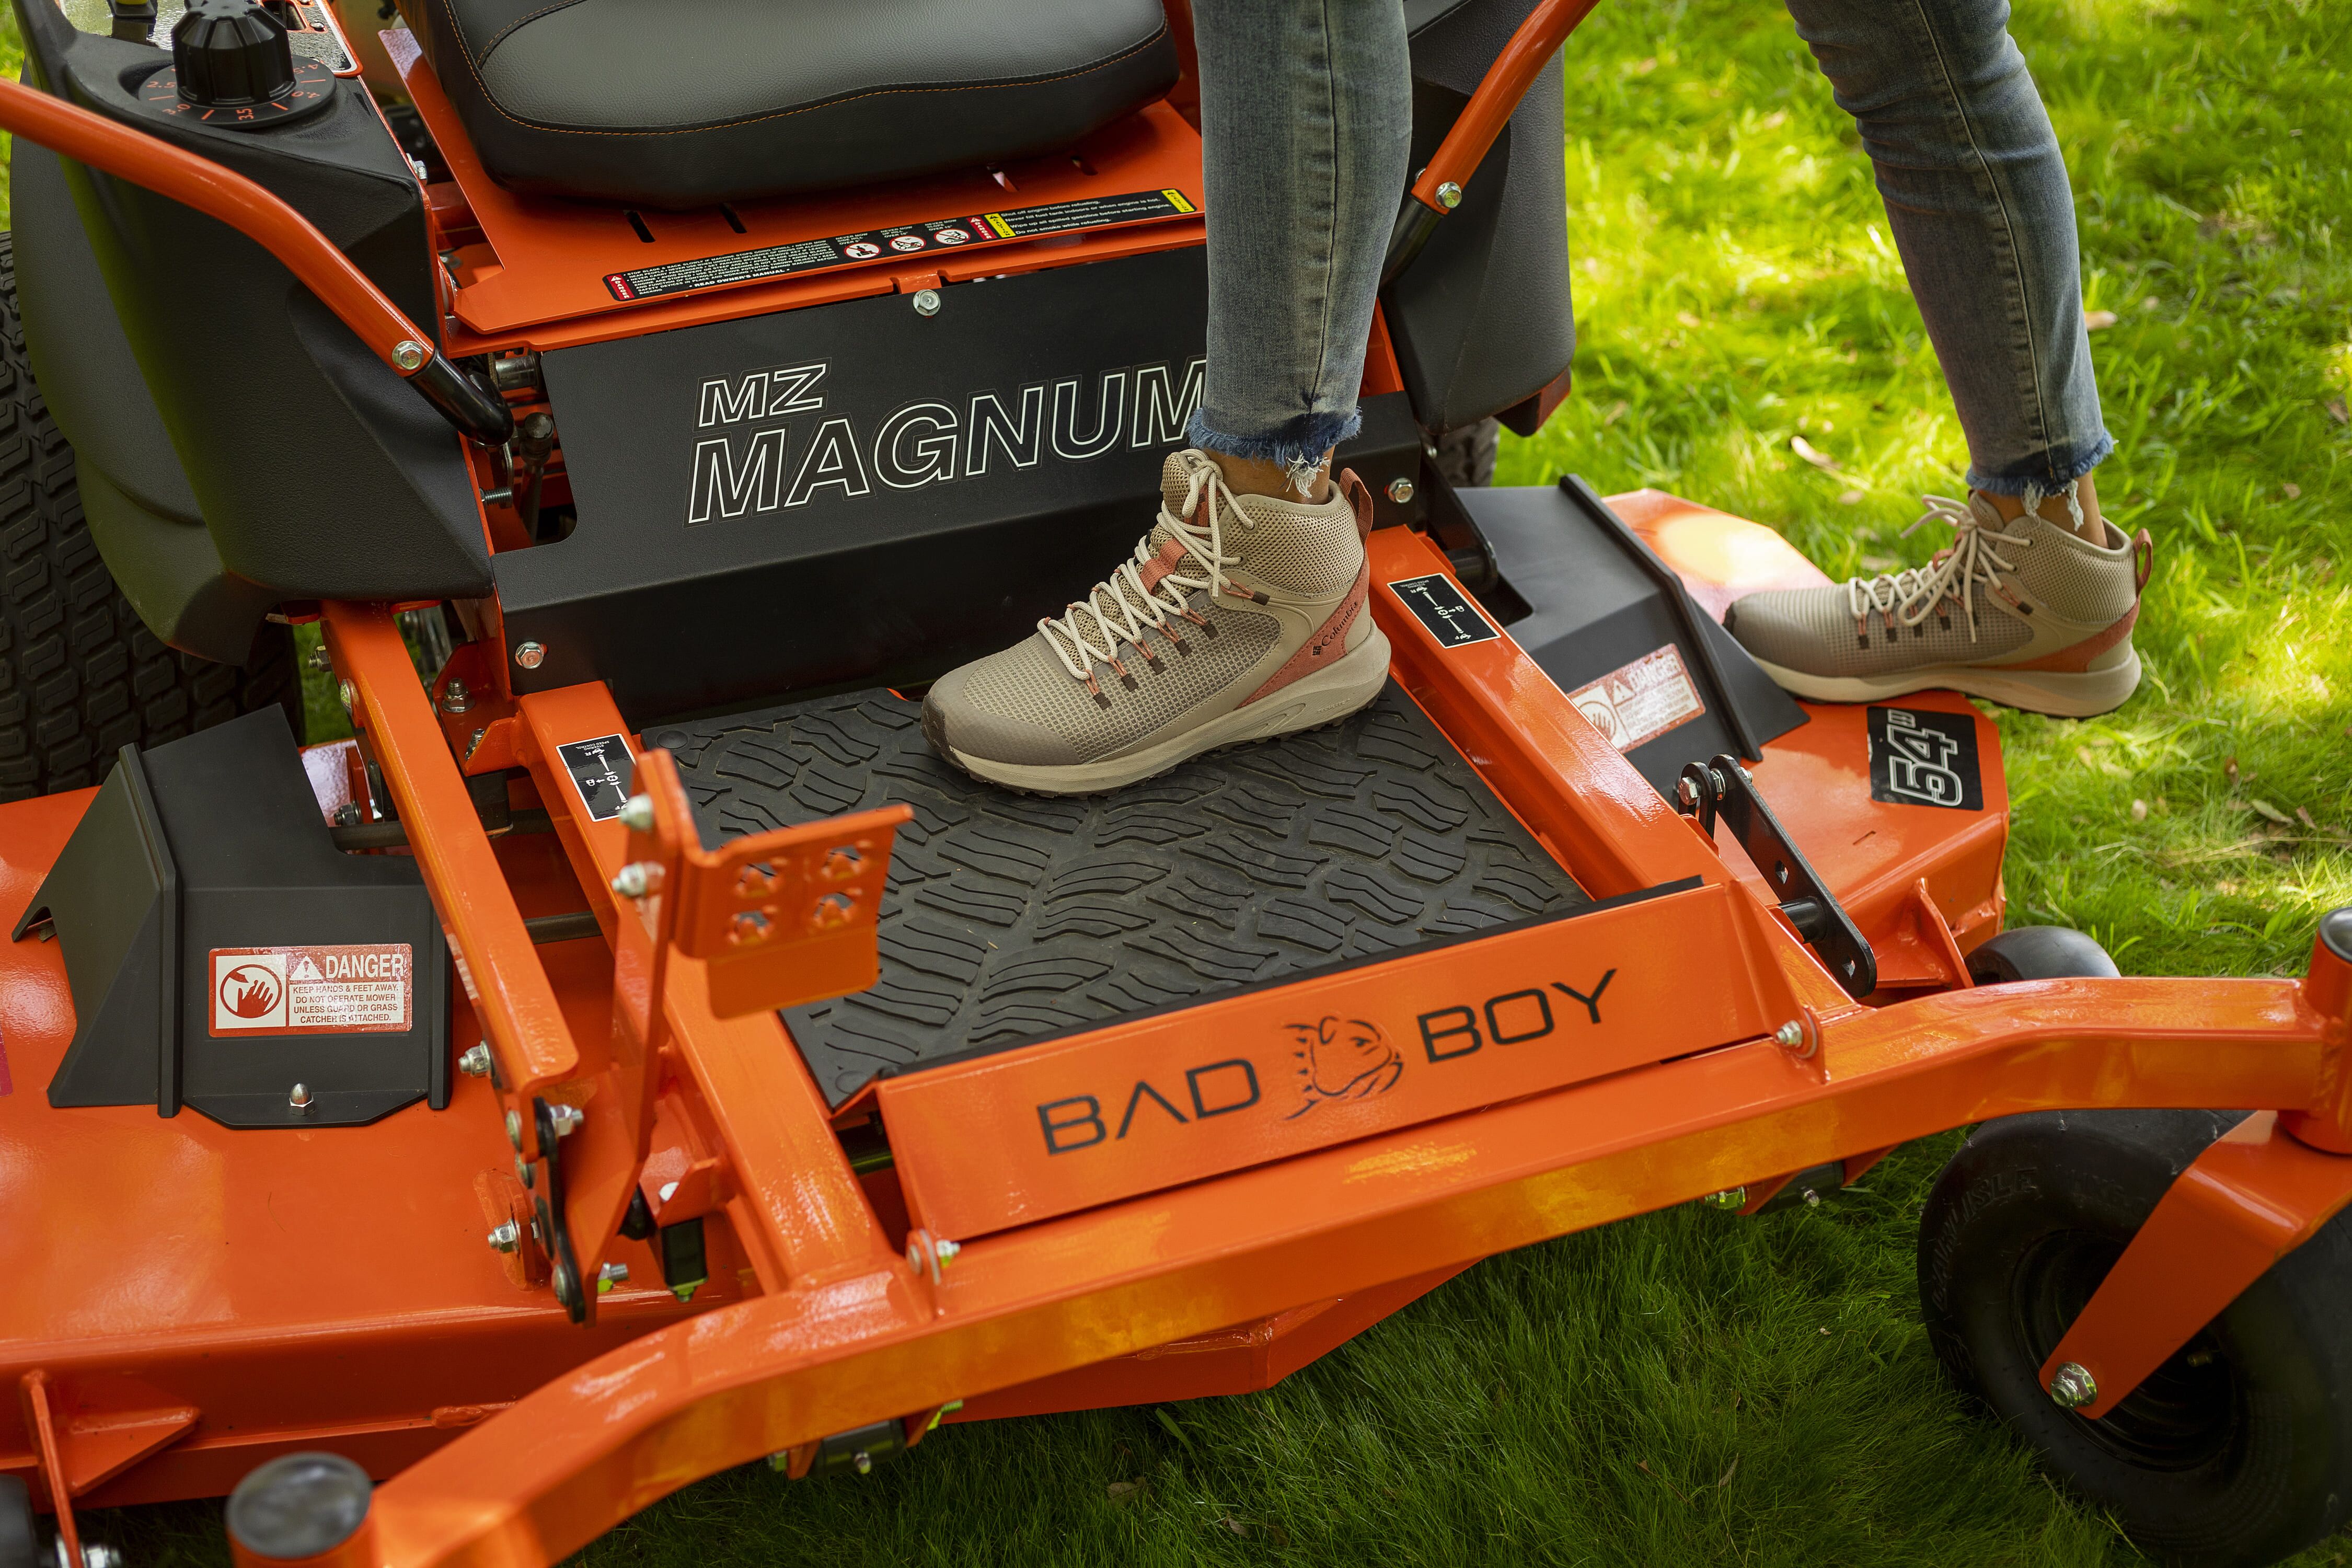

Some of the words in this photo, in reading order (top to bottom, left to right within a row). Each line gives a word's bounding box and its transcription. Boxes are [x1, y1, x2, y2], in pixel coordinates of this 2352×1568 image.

[162, 103, 192, 115] 3.0
[236, 108, 253, 121] 3.5
[974, 222, 993, 238] DANGER
[717, 274, 752, 283] OWNER'S
[614, 280, 630, 298] DANGER
[698, 363, 826, 428] MZ
[688, 359, 1207, 523] MAGNUM
[1321, 602, 1357, 647] Columbia
[326, 954, 405, 979] DANGER
[316, 985, 343, 993] HANDS
[309, 995, 325, 1004] NOT
[327, 994, 364, 1002] OPERATE
[366, 994, 396, 1002] MOWER
[294, 1005, 325, 1013] UNLESS
[300, 1015, 338, 1023] CATCHER
[349, 1013, 391, 1022] ATTACHED.
[1036, 1058, 1261, 1156] BAD
[1416, 968, 1618, 1065] BOY
